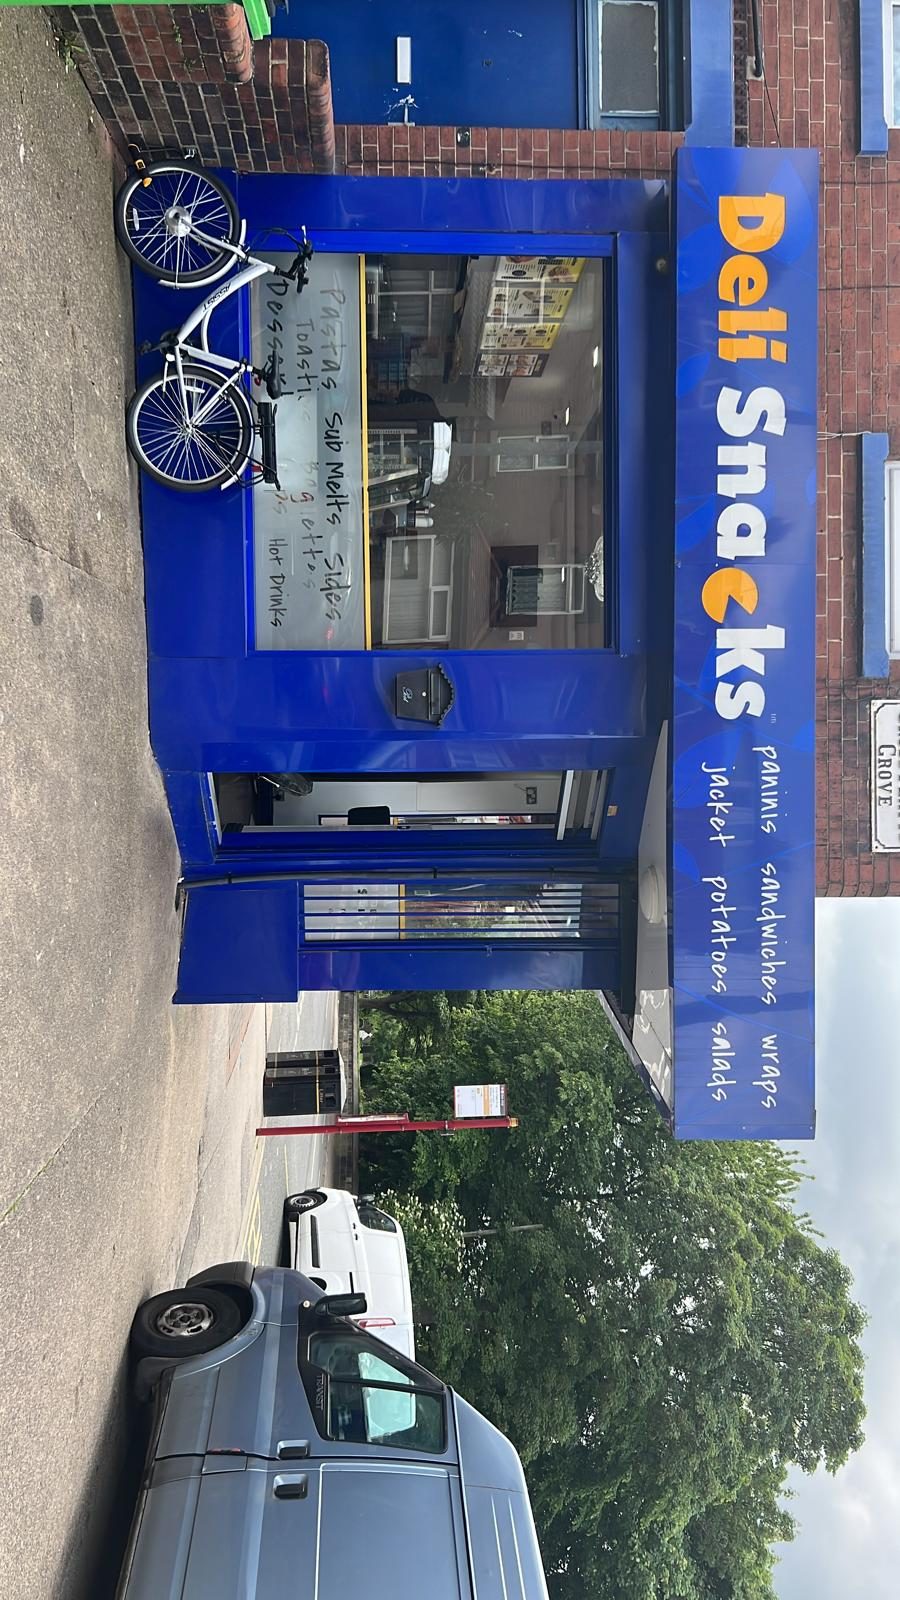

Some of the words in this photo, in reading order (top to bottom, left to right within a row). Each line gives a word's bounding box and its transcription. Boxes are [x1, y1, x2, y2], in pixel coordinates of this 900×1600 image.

[717, 192, 788, 364] Deli
[319, 288, 347, 391] Pastas
[323, 412, 349, 453] Sub
[324, 462, 350, 526] Melts
[268, 538, 289, 566] Hot
[319, 552, 351, 621] Sides
[701, 386, 787, 722] Snacks
[268, 574, 290, 628] Drinks
[701, 762, 736, 848] jacket
[752, 745, 789, 834] paninis
[878, 744, 897, 807] GROVE
[702, 876, 737, 994] potatoes
[758, 862, 788, 1005] sandwiches
[711, 1022, 738, 1102] salads
[749, 1034, 777, 1109] wraps
[315, 1373, 324, 1411] TRANSIT
